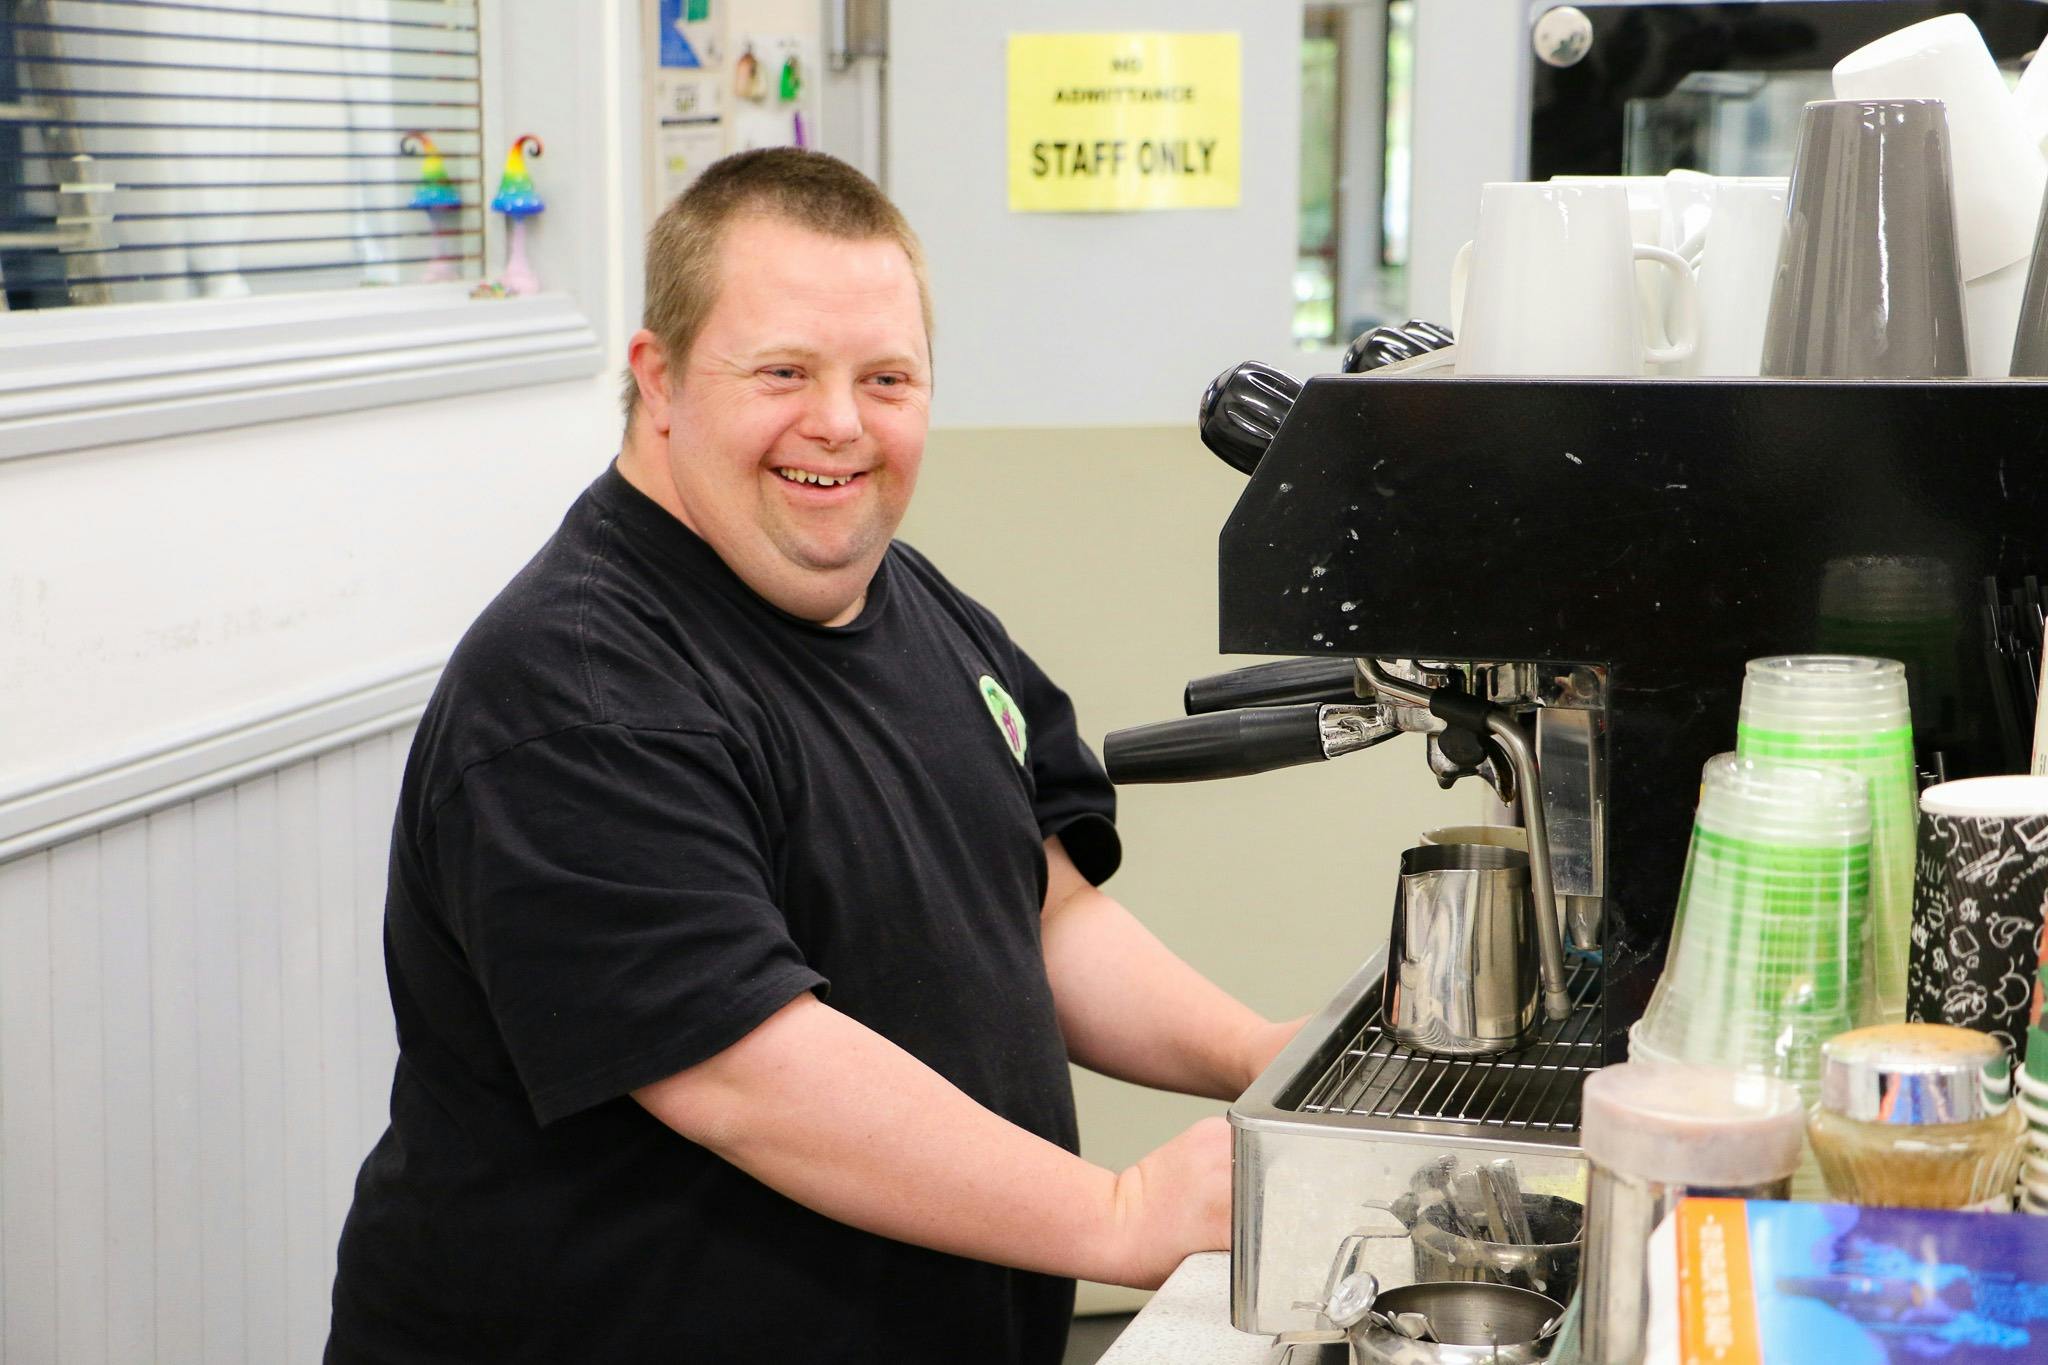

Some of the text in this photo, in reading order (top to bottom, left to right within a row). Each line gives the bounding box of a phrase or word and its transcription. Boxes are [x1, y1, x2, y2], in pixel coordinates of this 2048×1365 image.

[1110, 57, 1142, 73] NO
[1055, 86, 1195, 102] ADMITTANCE
[1031, 140, 1217, 177] STAFF ONLY
